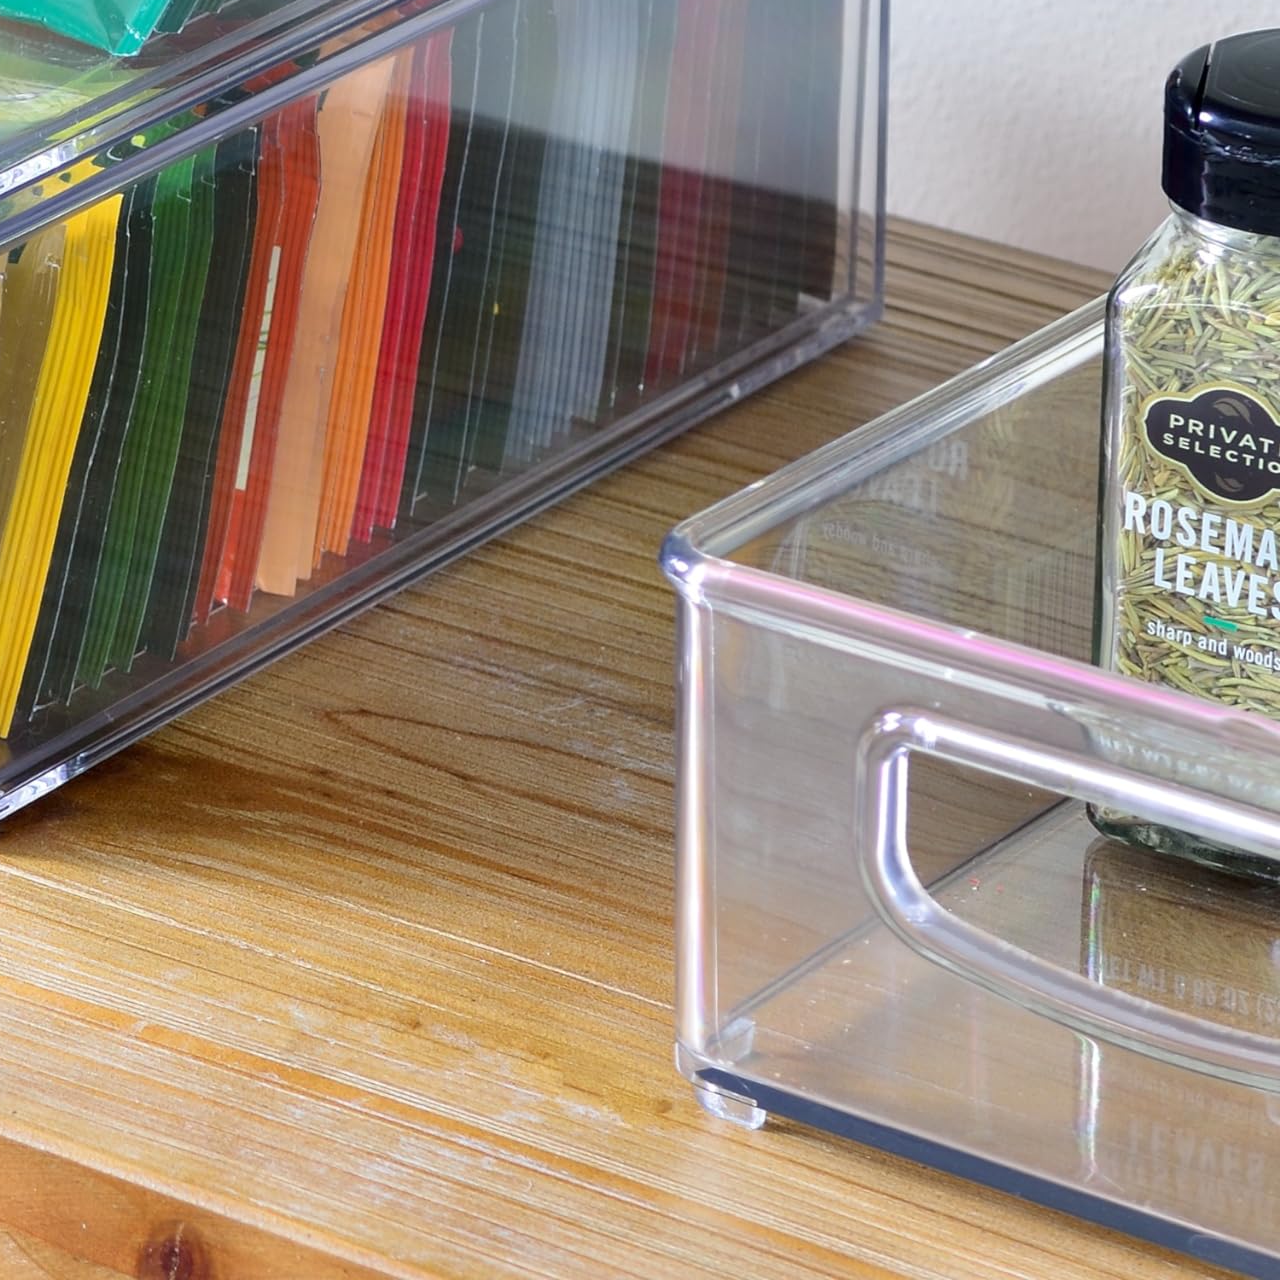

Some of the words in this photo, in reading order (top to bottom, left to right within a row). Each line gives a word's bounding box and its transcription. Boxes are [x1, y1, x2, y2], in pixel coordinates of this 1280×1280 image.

[1169, 413, 1280, 458] PRIVAT
[1124, 491, 1280, 572] ROSEMA
[1147, 619, 1192, 646] sharp
[1197, 636, 1228, 656] and
